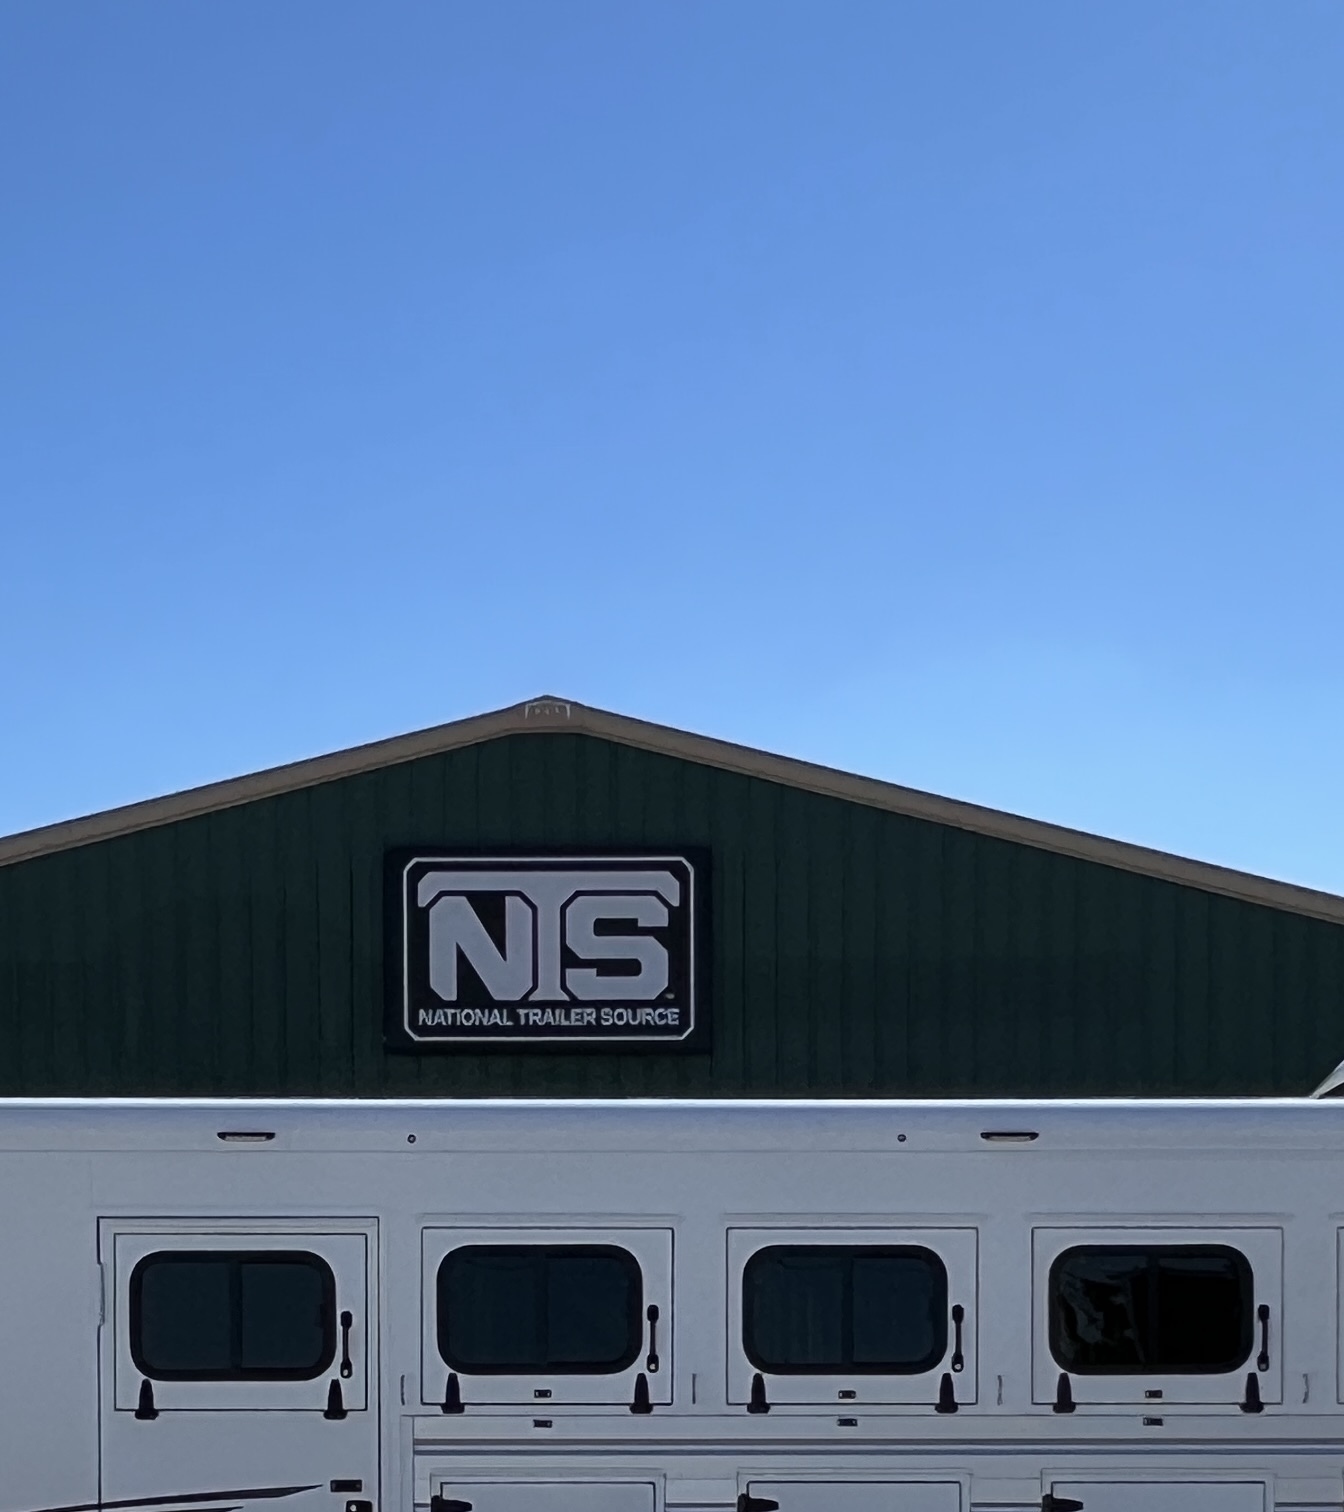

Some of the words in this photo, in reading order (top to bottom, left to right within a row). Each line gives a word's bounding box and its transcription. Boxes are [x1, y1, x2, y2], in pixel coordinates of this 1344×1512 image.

[418, 871, 680, 1001] NTS
[418, 1008, 513, 1026] NATIONAL
[516, 1008, 597, 1026] TRAILER
[600, 1008, 680, 1026] SOURCE
